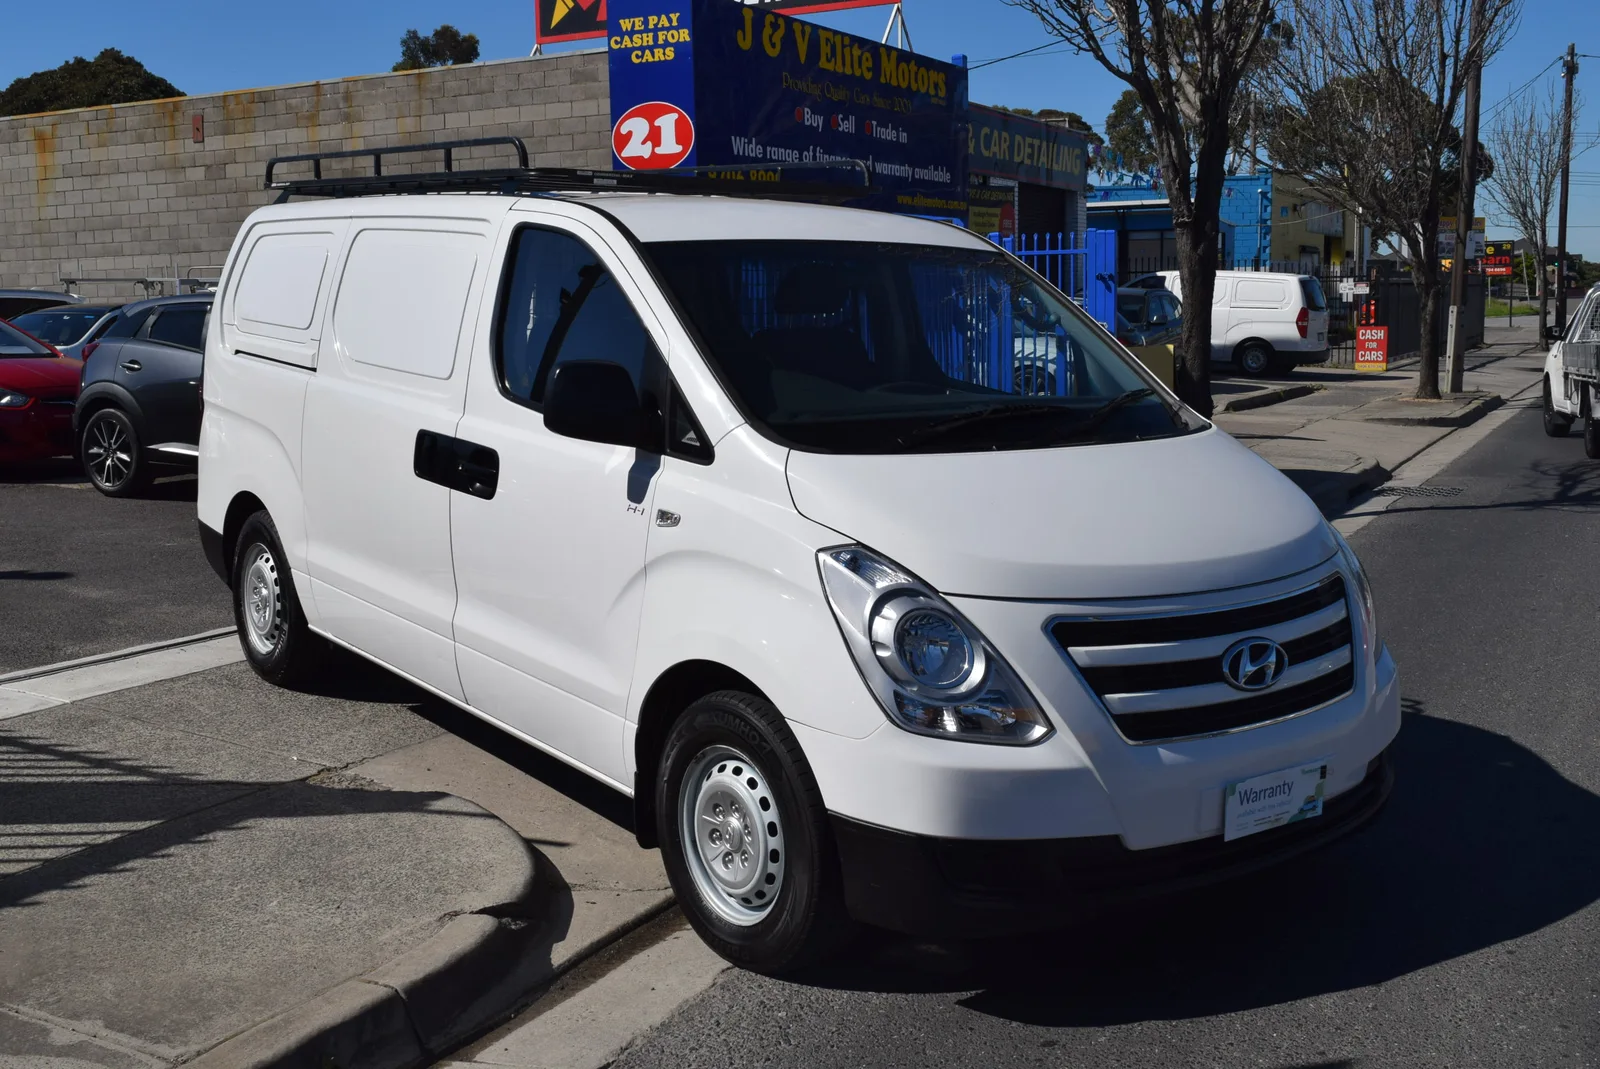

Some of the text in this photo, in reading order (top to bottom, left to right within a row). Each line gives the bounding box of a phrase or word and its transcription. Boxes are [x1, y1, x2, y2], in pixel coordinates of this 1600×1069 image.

[619, 12, 680, 32] WE PAY
[610, 29, 691, 49] CASH FOR
[631, 47, 675, 64] CARS
[737, 7, 947, 98] J & V Elite Motors
[782, 72, 823, 102] Providing
[824, 81, 851, 107] Quality
[853, 87, 870, 104] Cars
[620, 113, 683, 159] 21
[804, 107, 908, 144] Buy Sell Trade in
[731, 135, 763, 158] Wide
[766, 145, 800, 163] range
[802, 145, 814, 162] of
[874, 160, 913, 182] warranty
[914, 164, 951, 184] available
[980, 126, 1010, 161] CAR
[1013, 134, 1082, 176] DETAILING
[1359, 329, 1385, 340] CASH
[1365, 341, 1377, 349] FOR
[1358, 351, 1384, 361] CARS
[1238, 780, 1294, 806] Warranty
